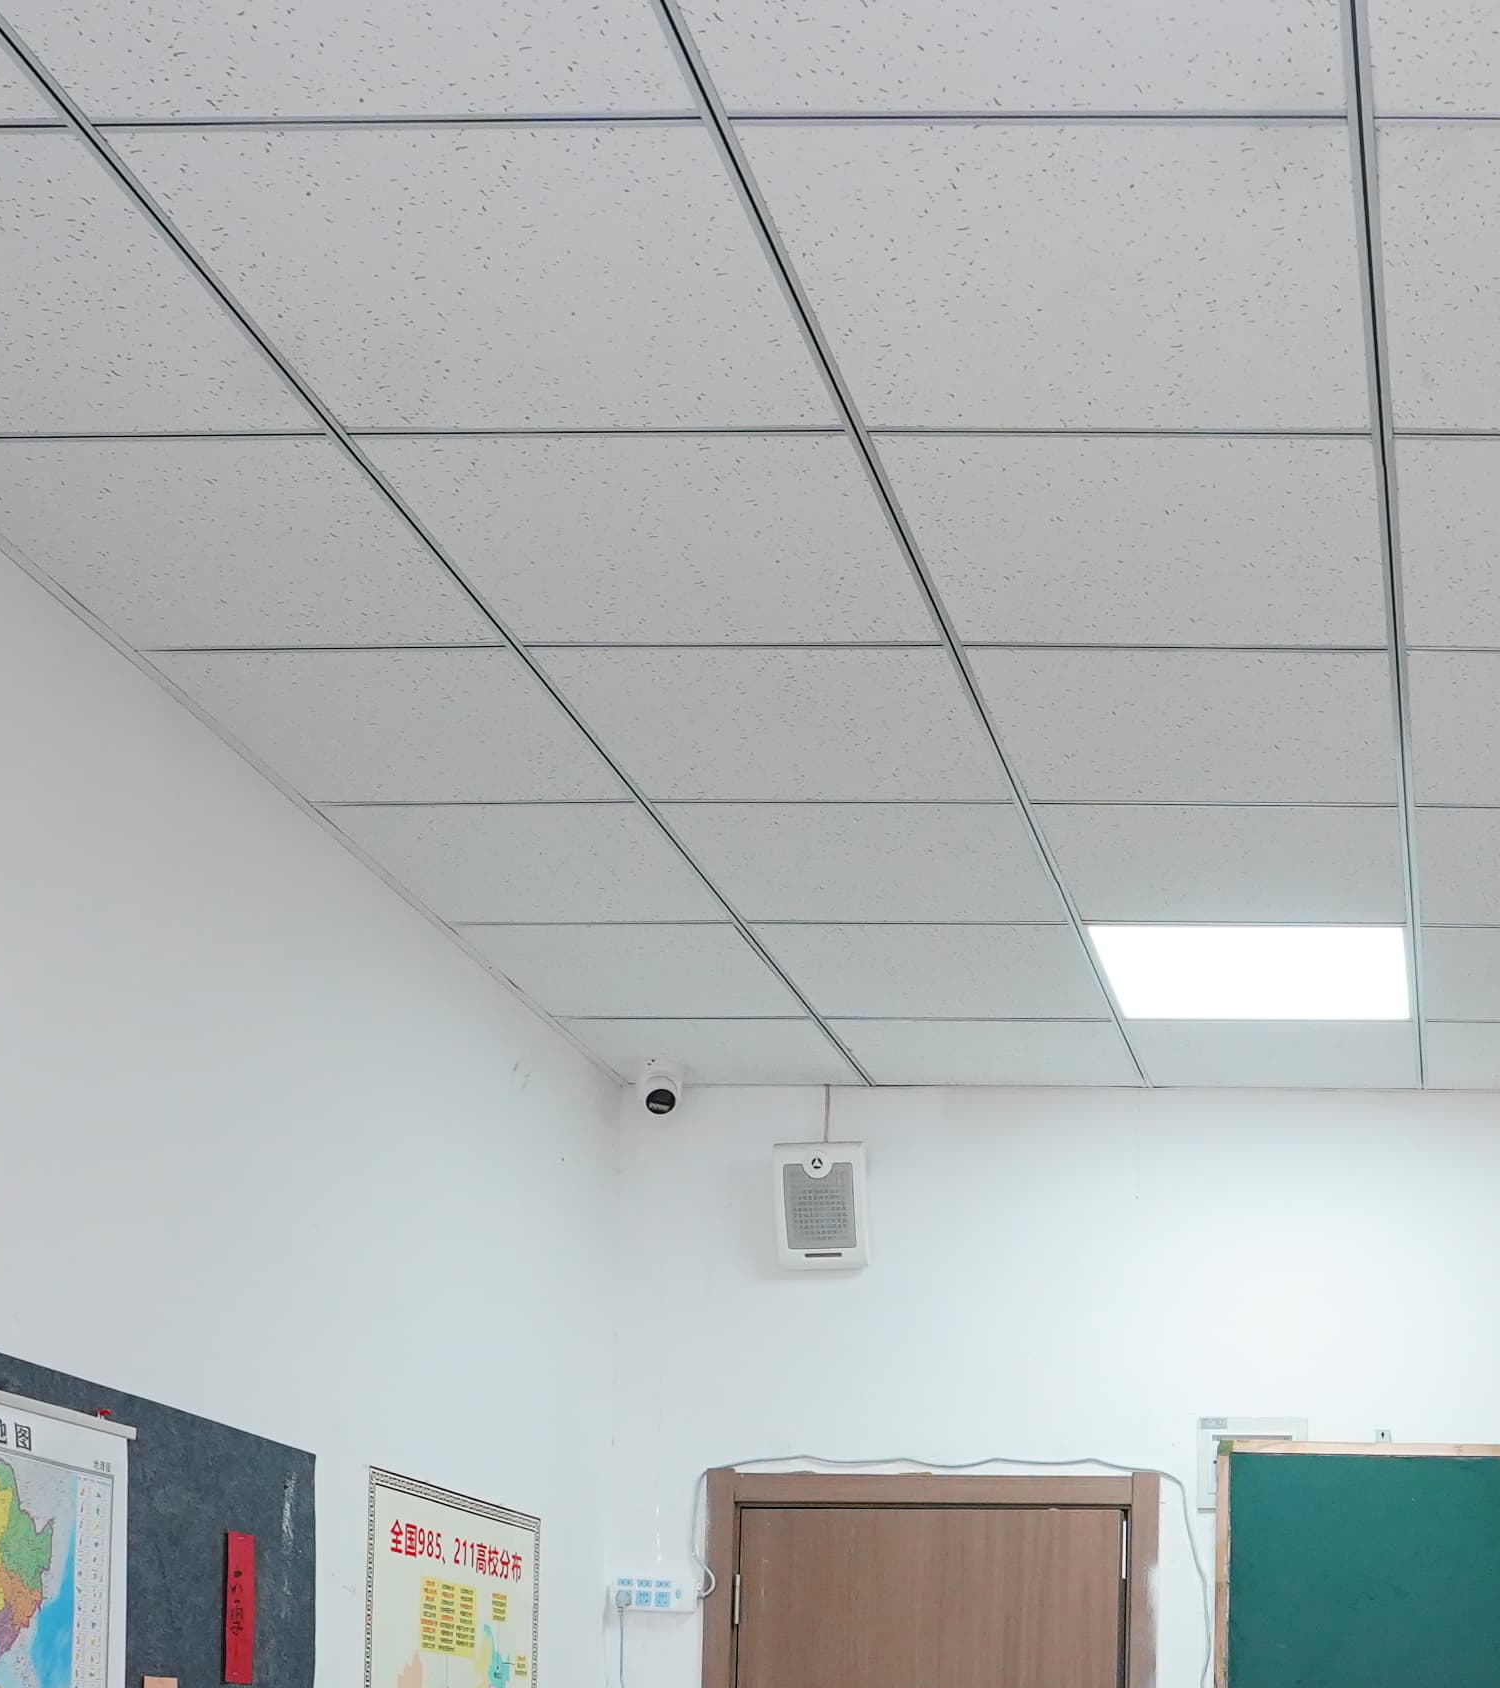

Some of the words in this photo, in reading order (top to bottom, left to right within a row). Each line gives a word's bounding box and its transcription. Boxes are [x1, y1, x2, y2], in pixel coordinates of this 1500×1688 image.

[390, 1519, 523, 1583] 全国985、211高校分布
